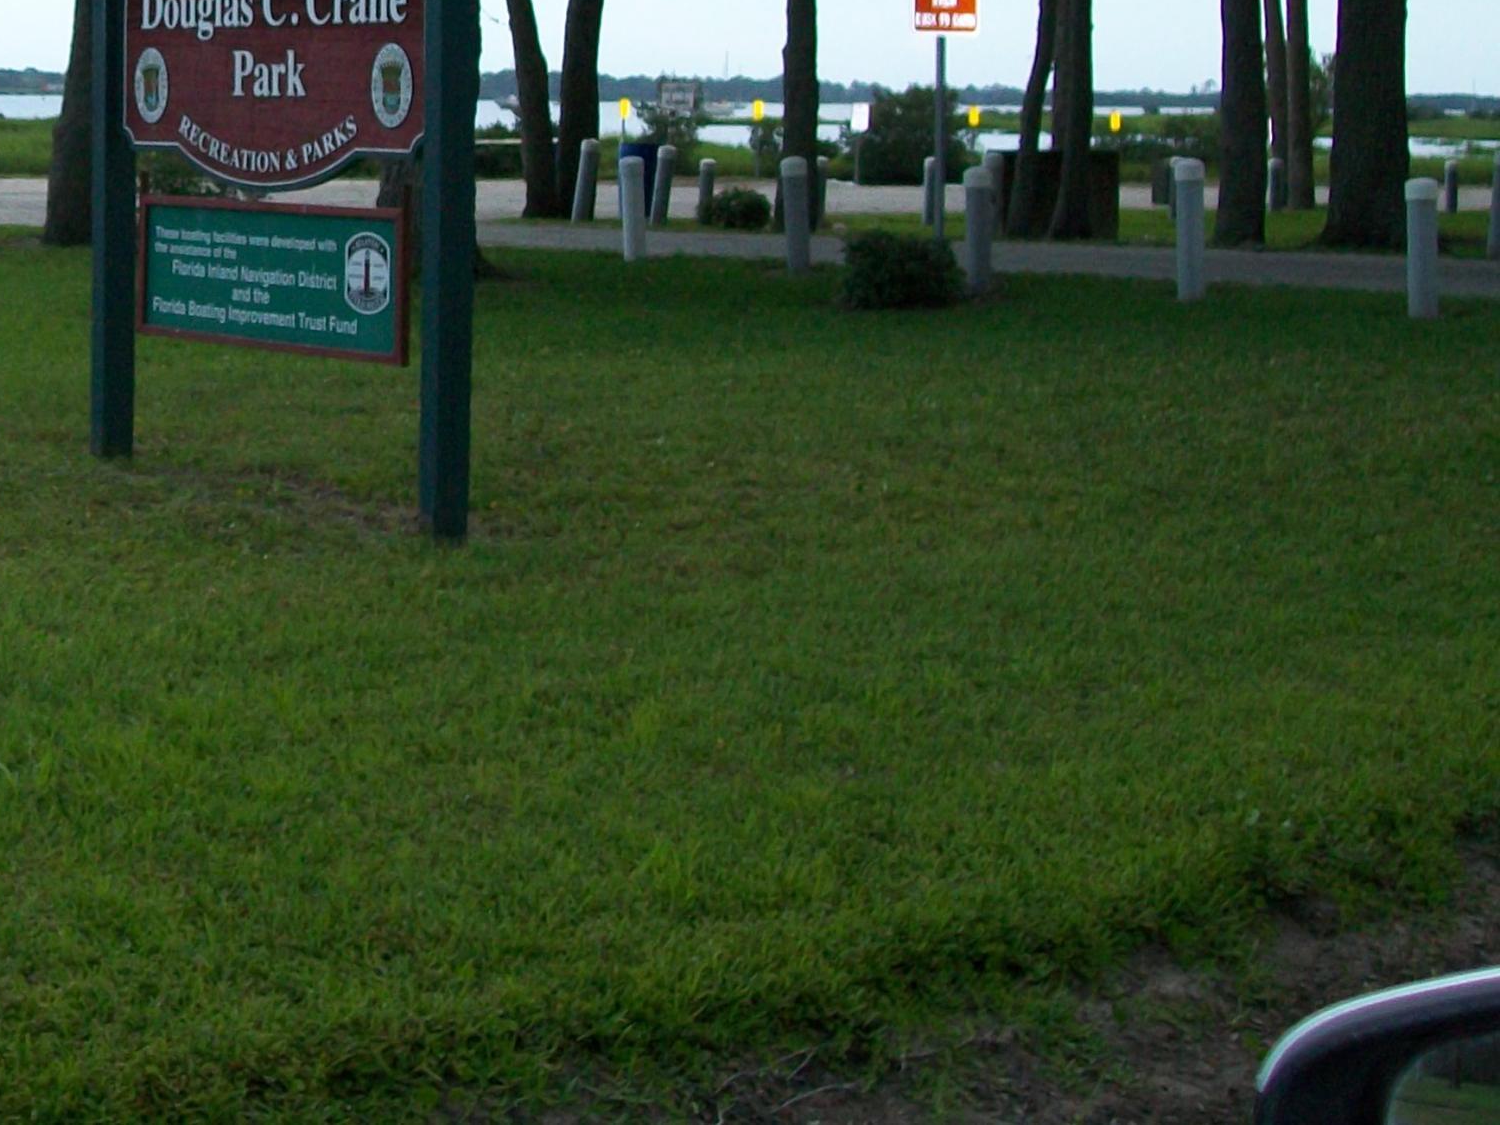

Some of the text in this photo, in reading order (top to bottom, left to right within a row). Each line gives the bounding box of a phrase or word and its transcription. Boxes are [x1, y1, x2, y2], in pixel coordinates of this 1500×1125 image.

[232, 48, 308, 98] Park
[178, 113, 359, 174] RECREATION & PARKS
[155, 242, 168, 253] the
[213, 247, 222, 258] of
[270, 235, 316, 253] developed
[317, 238, 337, 252] with
[171, 259, 337, 291] Florida Inland Navigation District
[232, 287, 270, 305] and the
[152, 296, 358, 335] Florida Boating Improvement Trust Fund
